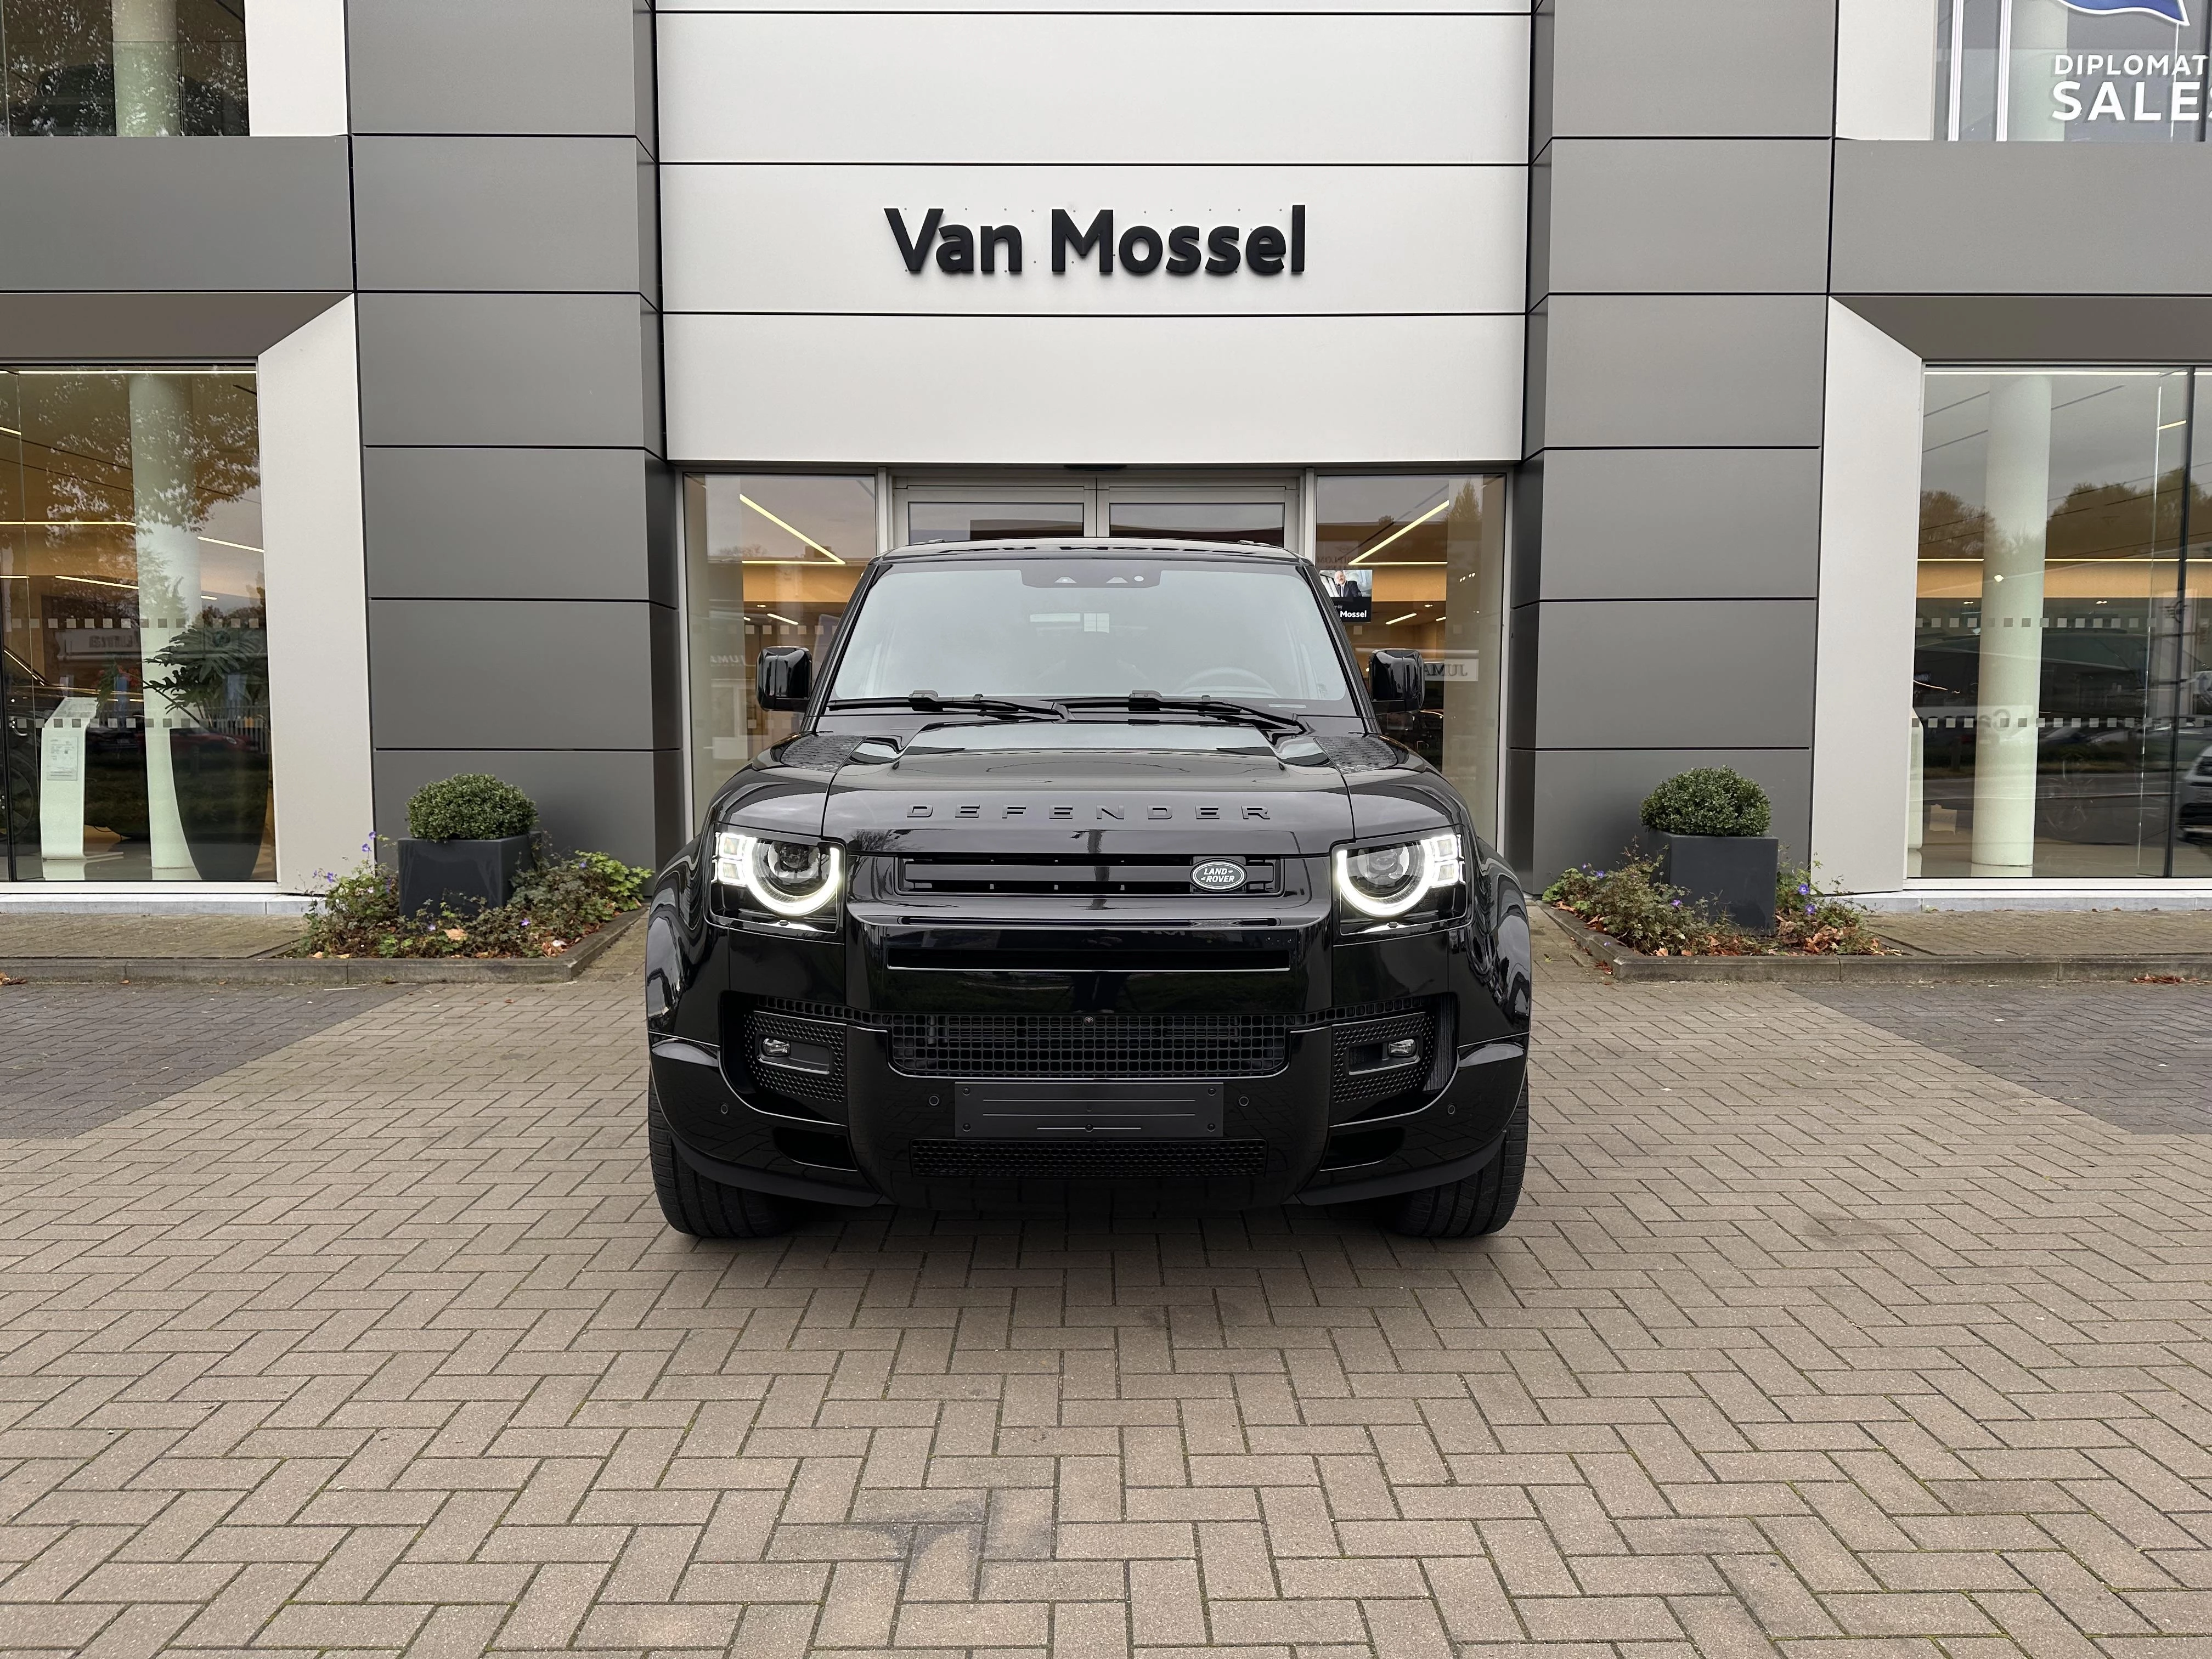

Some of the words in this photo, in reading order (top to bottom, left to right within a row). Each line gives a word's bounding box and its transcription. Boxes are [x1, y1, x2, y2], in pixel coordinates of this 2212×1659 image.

[2054, 54, 2209, 76] DIPLOMAT
[2052, 81, 2212, 121] SALE
[883, 207, 1023, 273] Van
[1051, 205, 1306, 274] Mossel
[1340, 610, 1367, 618] Mossel
[906, 804, 1271, 820] DEFENDER
